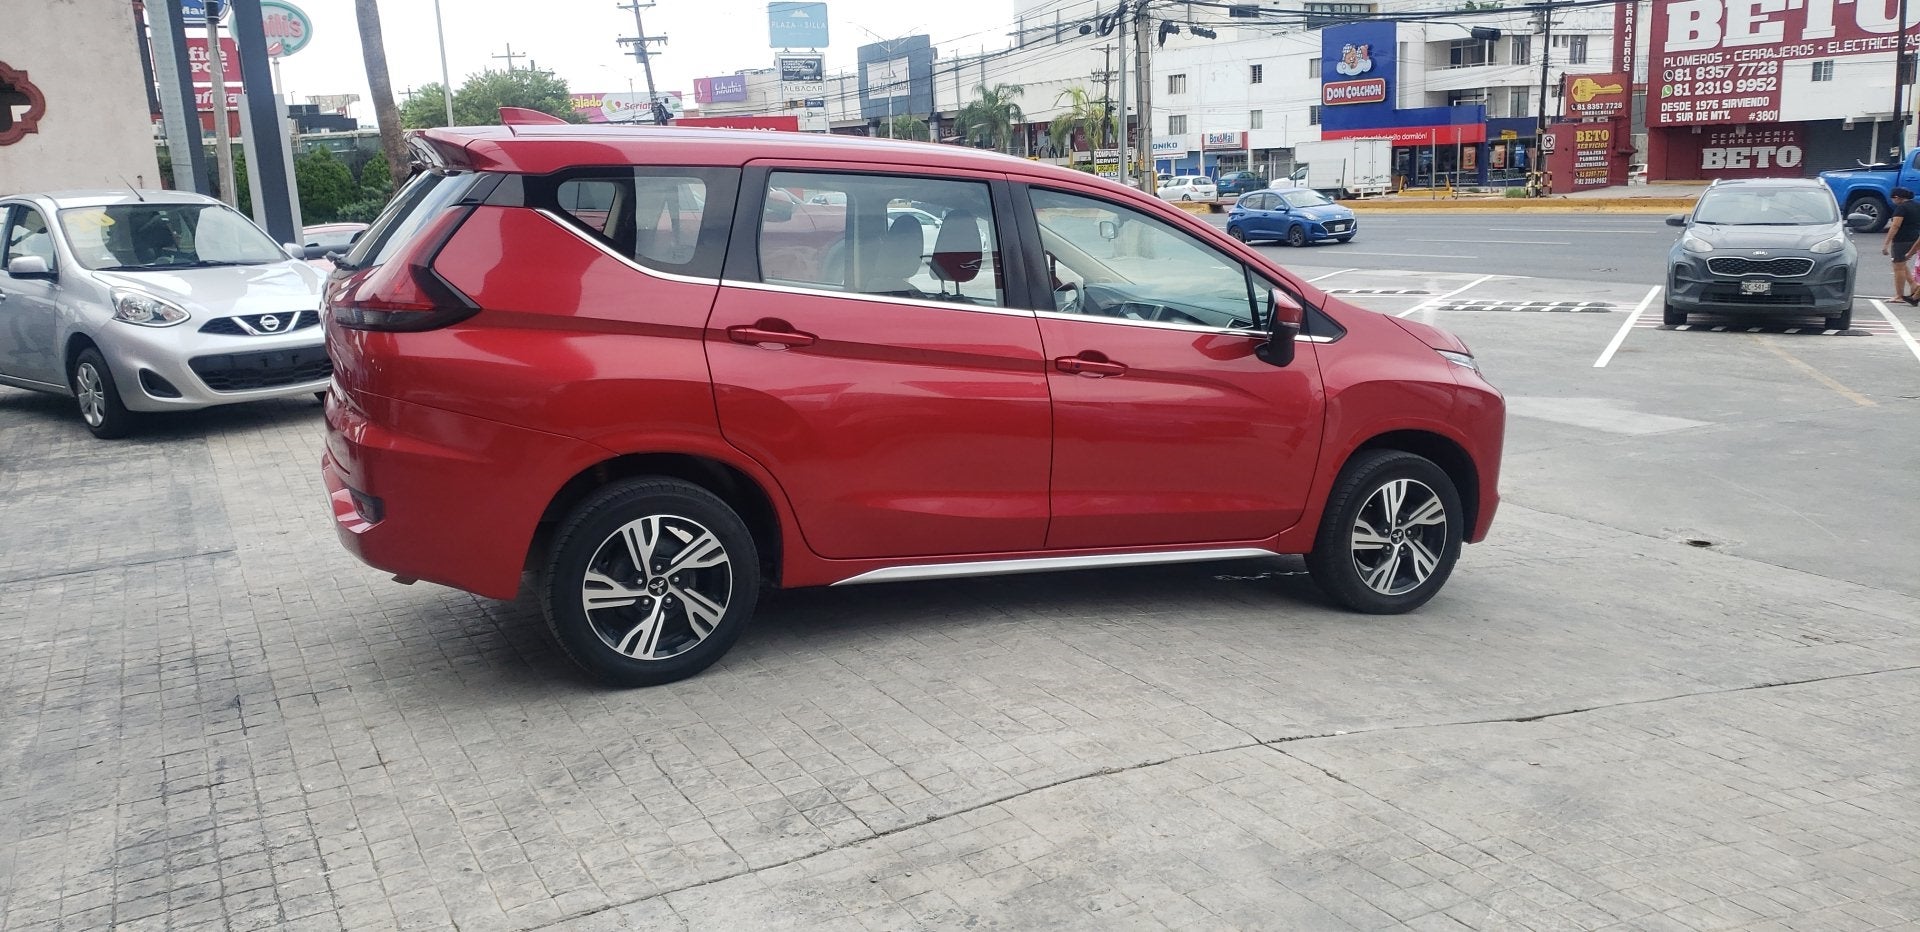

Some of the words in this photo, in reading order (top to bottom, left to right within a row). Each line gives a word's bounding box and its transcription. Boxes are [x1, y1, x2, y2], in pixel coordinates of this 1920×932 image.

[1663, 52, 1724, 68] PLOMEROS
[1734, 43, 1815, 62] CERRAJEROS
[1827, 33, 1920, 54] ELECTRICISAS
[1674, 68, 1692, 81] 81
[1695, 64, 1734, 80] 8357
[1738, 60, 1778, 77] 7728
[1327, 87, 1345, 101] DON
[1346, 84, 1382, 99] COLCHON
[1673, 83, 1691, 97] 81
[1694, 80, 1733, 96] 2319
[1736, 76, 1777, 93] 9952
[624, 101, 653, 111] Sorian
[1577, 103, 1586, 111] 81
[1605, 102, 1622, 110] 7728
[1661, 101, 1691, 112] DESDE
[1695, 100, 1719, 111] 1976
[1721, 96, 1770, 109] SIRVIENDO
[1660, 113, 1672, 122] EL
[1675, 112, 1693, 122] SUR
[1695, 111, 1708, 121] DE
[1710, 110, 1731, 121] MTY.
[1748, 110, 1778, 122] #3801
[1576, 130, 1610, 142] BETO
[1711, 130, 1795, 139] CERRAJERIA
[1711, 136, 1795, 145] FERRETERIA
[1701, 145, 1803, 170] BETO
